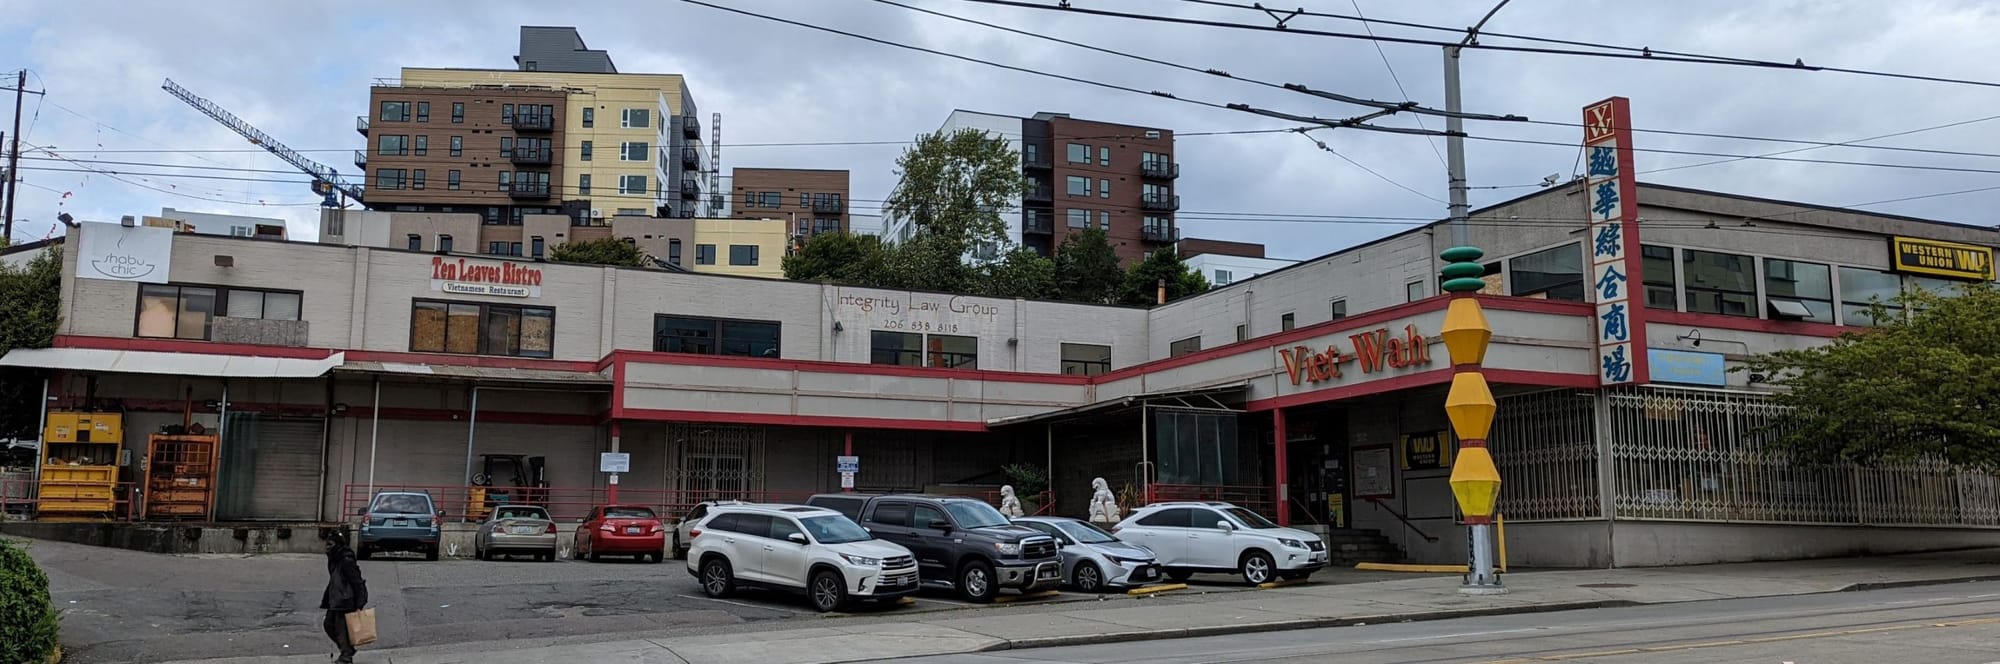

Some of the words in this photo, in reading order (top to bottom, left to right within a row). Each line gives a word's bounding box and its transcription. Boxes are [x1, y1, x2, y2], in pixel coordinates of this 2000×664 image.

[1902, 243, 1952, 258] WESTERN
[104, 253, 145, 265] shabu
[1590, 146, 1630, 382] 越華綜合商場
[1919, 255, 1953, 269] UNION
[1956, 249, 1985, 272] WU
[111, 264, 137, 275] chic
[432, 256, 456, 280] Ten
[458, 258, 501, 283] Leaves
[502, 261, 542, 286] Bistro
[447, 283, 485, 292] Vietnamese
[488, 286, 525, 295] Restaurant
[837, 287, 900, 315] Integrity
[909, 291, 940, 312] Law
[949, 295, 999, 322] Group
[884, 319, 904, 329] 206
